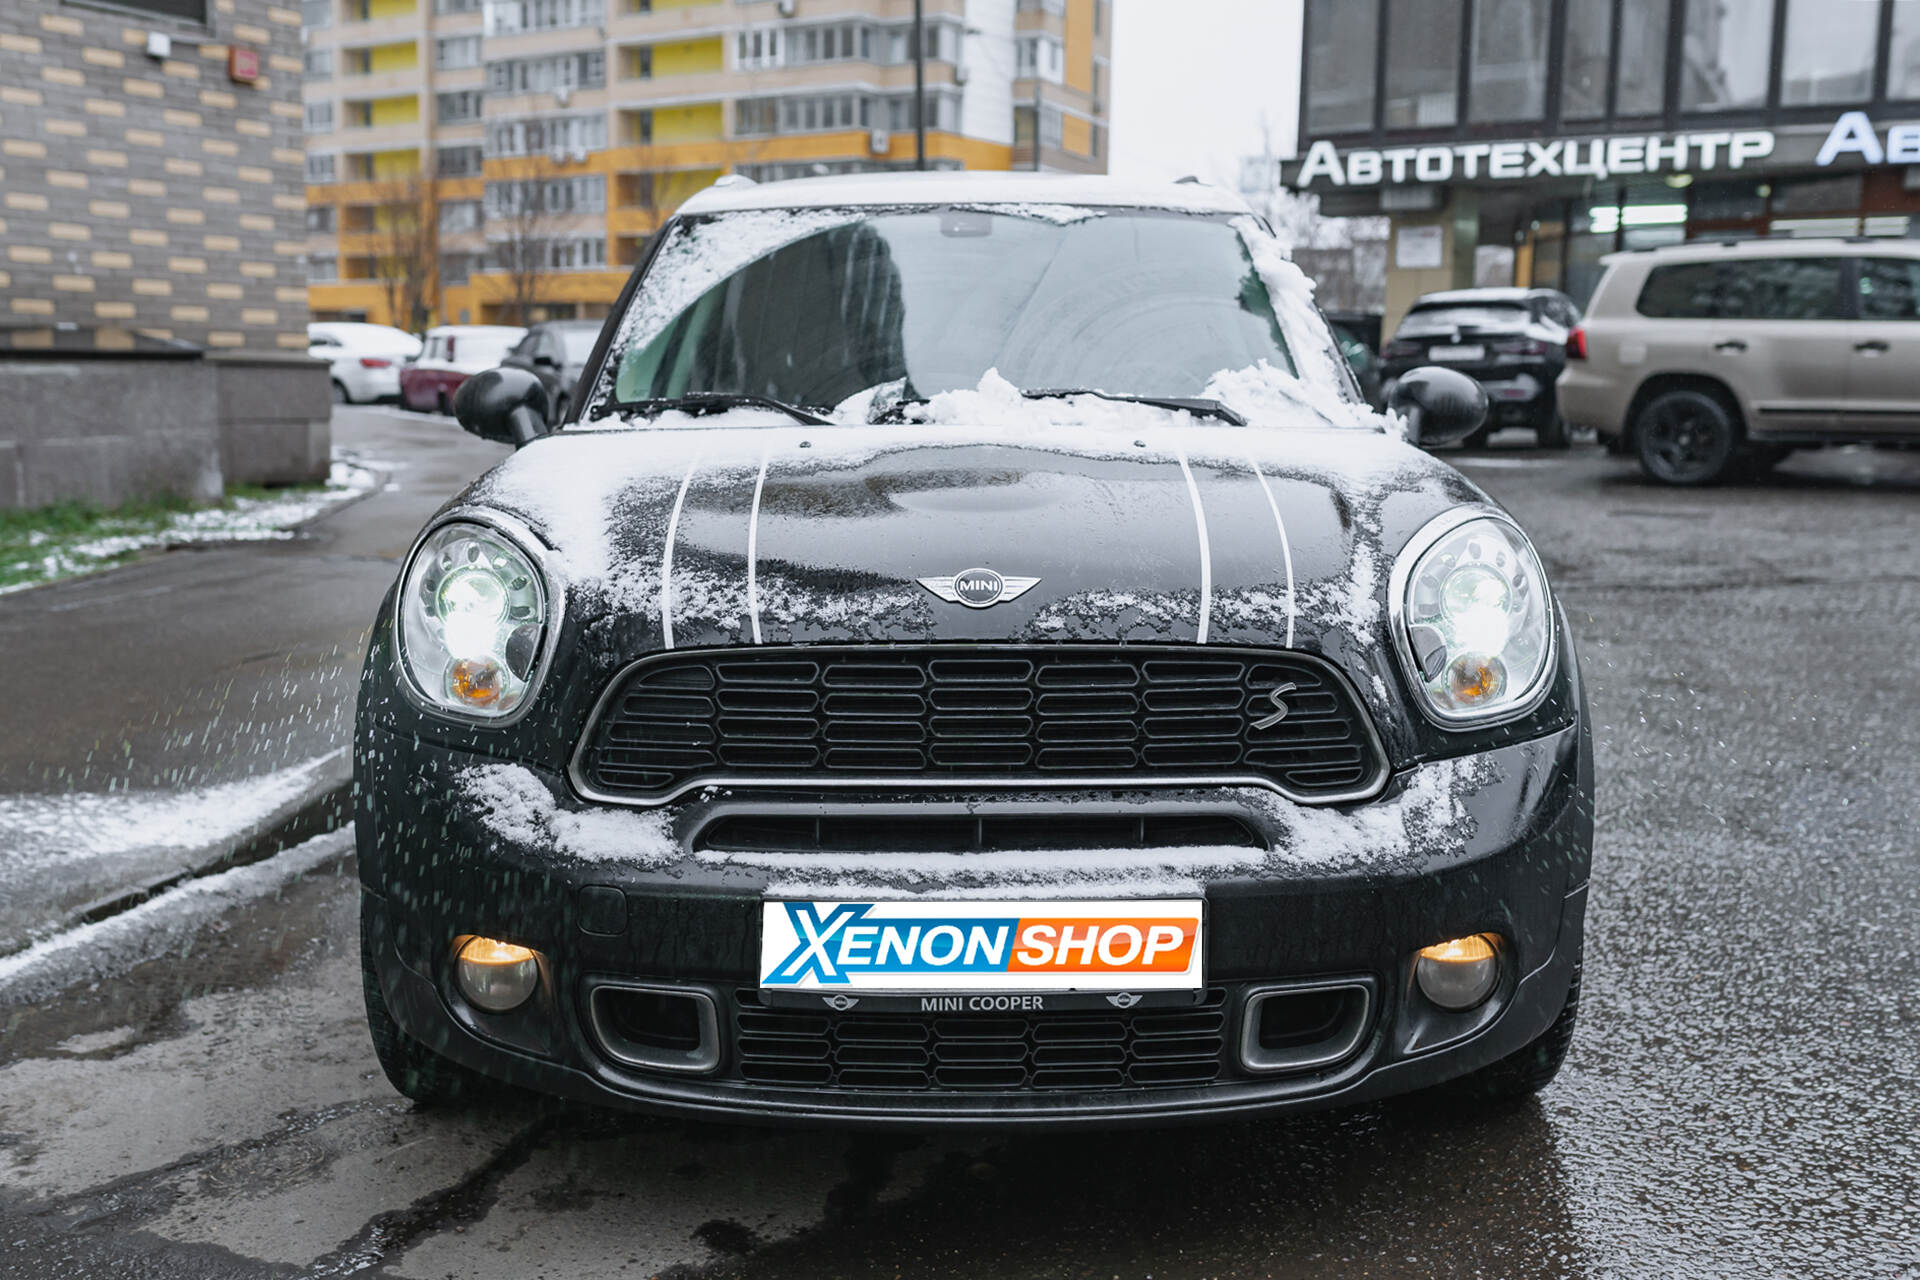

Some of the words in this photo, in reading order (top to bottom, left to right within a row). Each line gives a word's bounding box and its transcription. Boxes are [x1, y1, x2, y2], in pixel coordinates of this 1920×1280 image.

[1296, 130, 1775, 187] АВТОТЕХЦЕНТР
[959, 580, 998, 592] MINI
[777, 907, 1010, 978] XENON
[1016, 924, 1184, 967] SHOP
[921, 997, 963, 1012] MINI
[969, 996, 1044, 1011] COOPER
